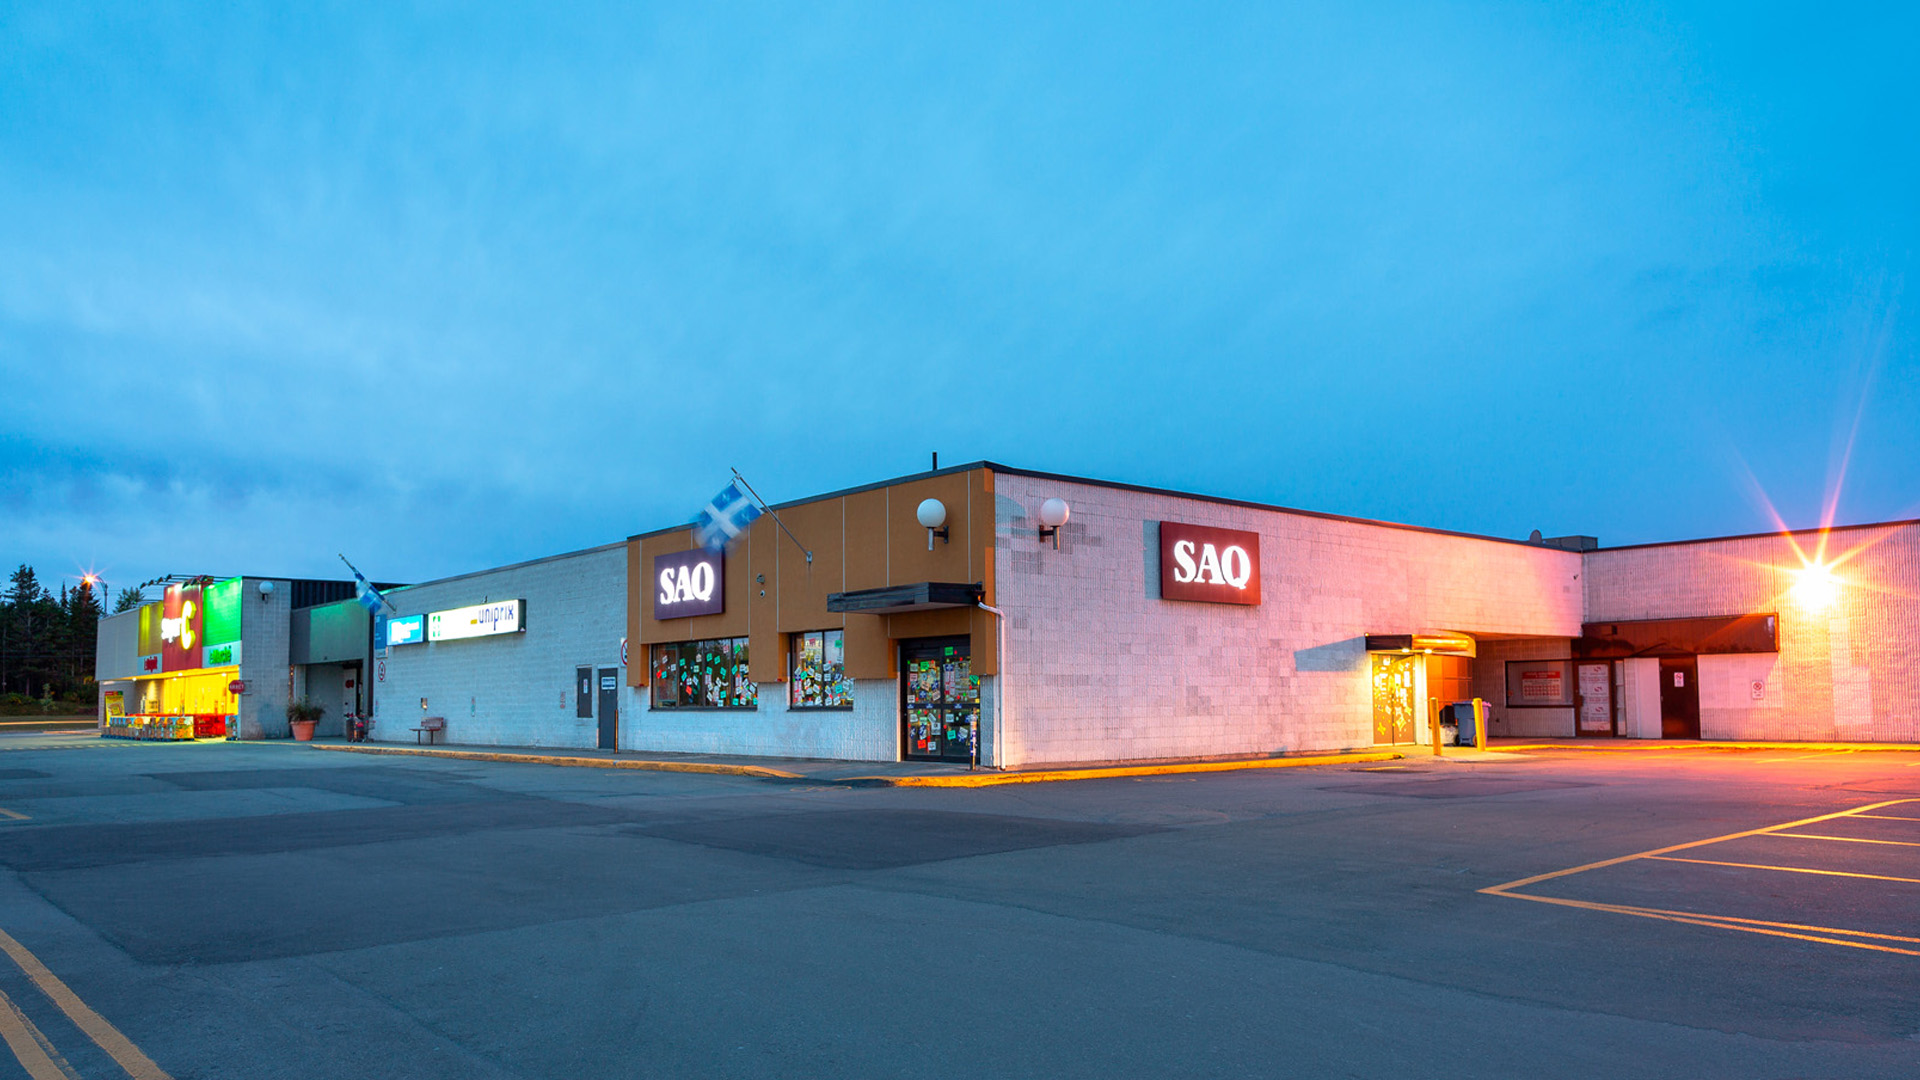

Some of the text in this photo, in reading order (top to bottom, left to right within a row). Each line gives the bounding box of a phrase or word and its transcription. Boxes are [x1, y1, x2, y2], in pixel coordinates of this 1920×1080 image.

[660, 561, 715, 605] SAQ
[1174, 540, 1251, 590] SAQ
[478, 604, 514, 631] uniprix
